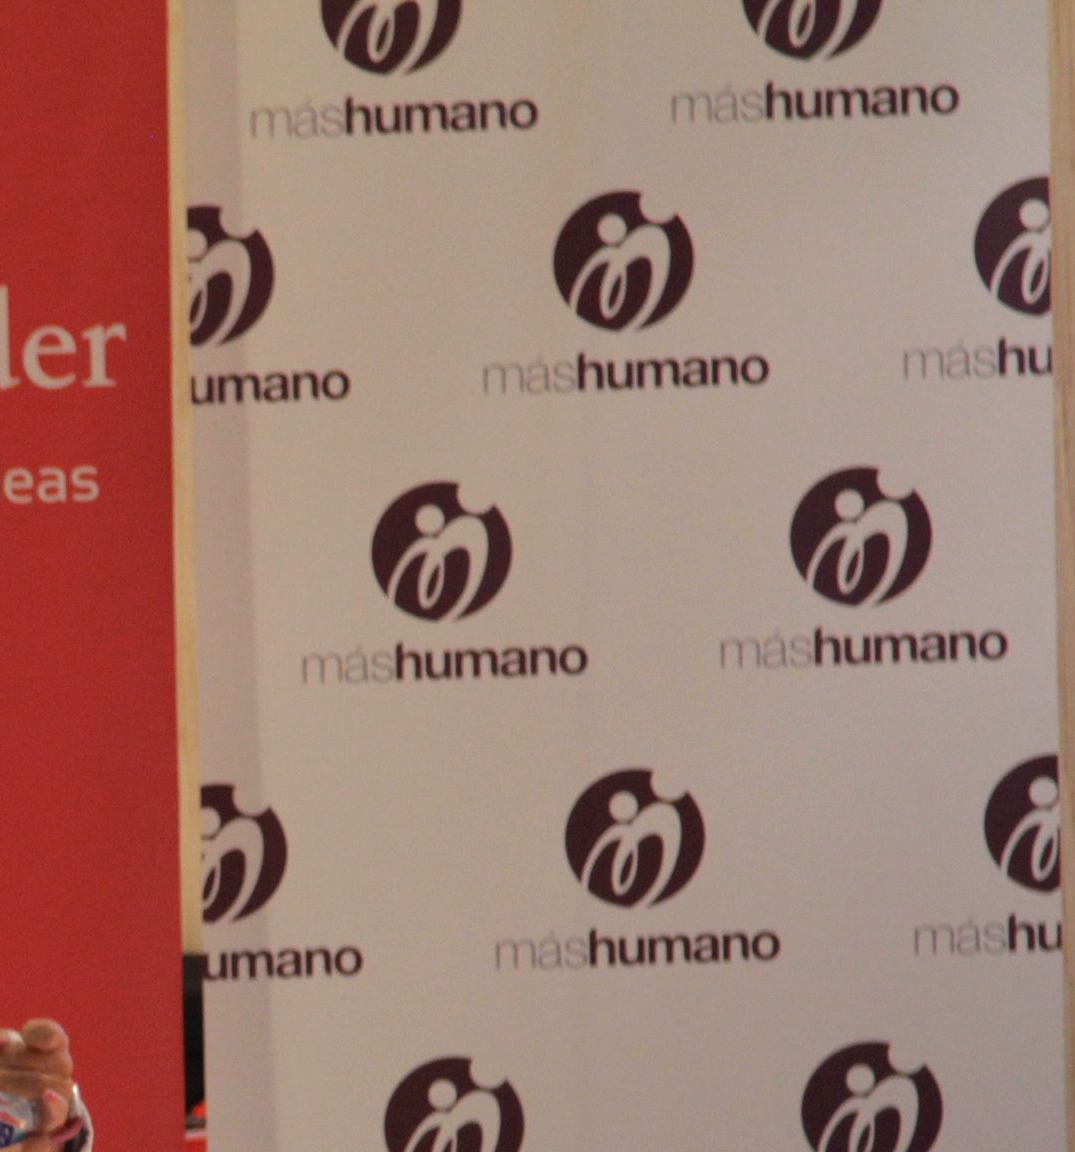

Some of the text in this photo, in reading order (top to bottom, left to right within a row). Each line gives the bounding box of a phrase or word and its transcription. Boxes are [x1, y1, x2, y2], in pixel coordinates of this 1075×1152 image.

[249, 92, 541, 139] máshumano
[669, 78, 961, 125] máshumano
[482, 349, 771, 395] máshumano
[302, 638, 590, 685] máshumano
[719, 624, 1010, 670] máshumano
[495, 925, 782, 971] máshumano
